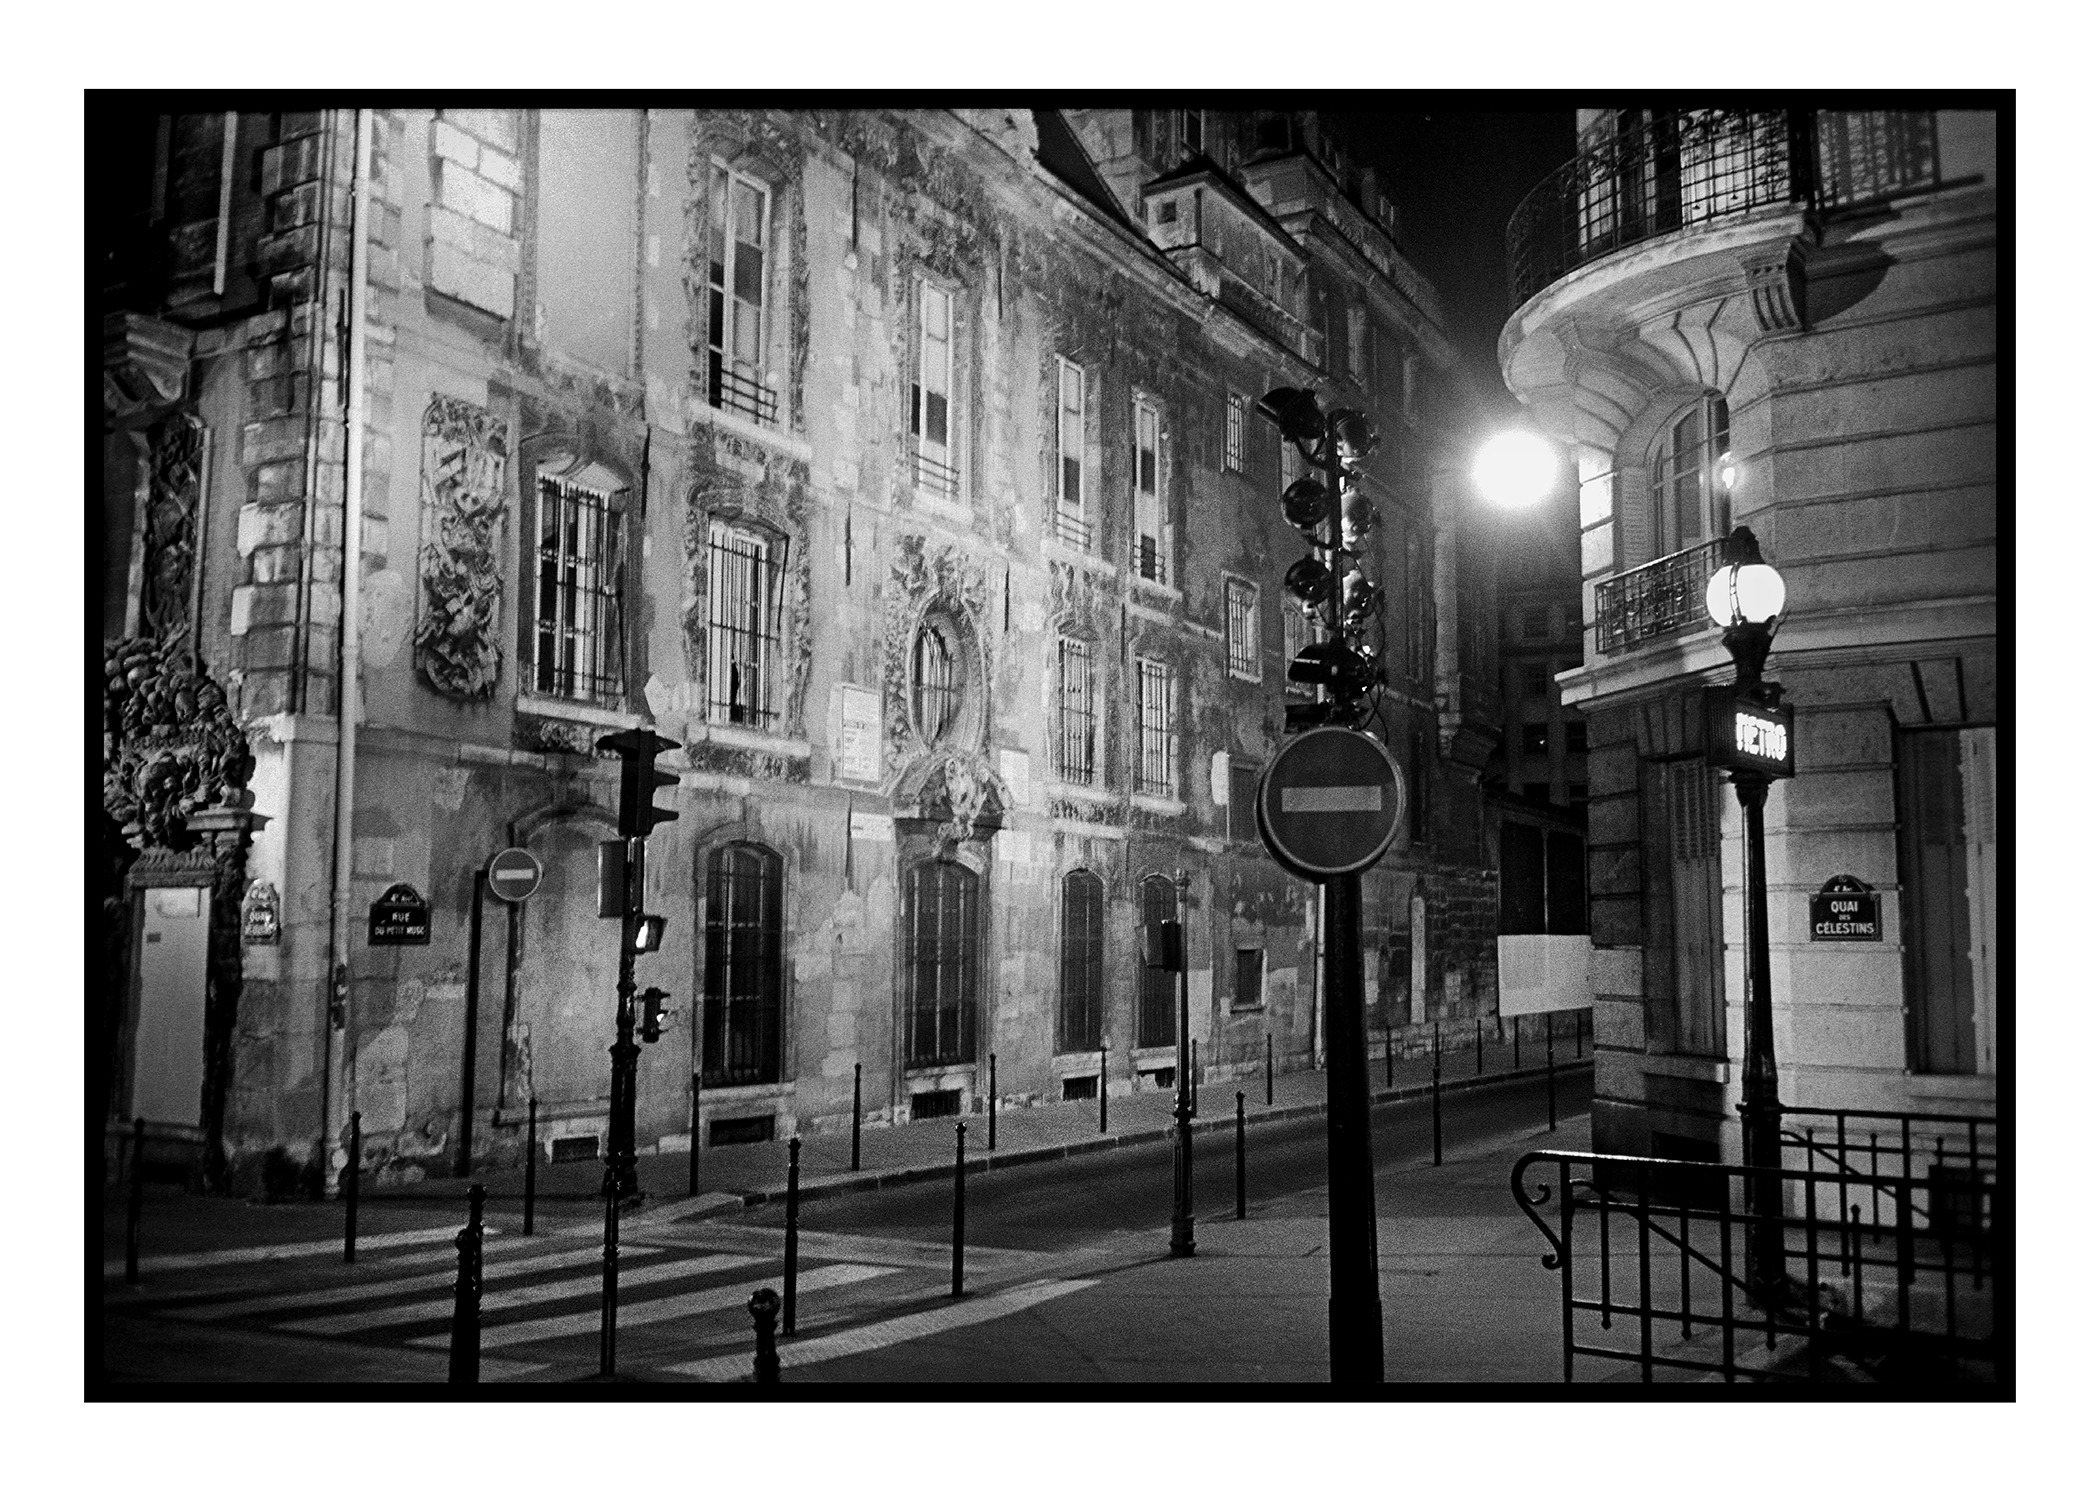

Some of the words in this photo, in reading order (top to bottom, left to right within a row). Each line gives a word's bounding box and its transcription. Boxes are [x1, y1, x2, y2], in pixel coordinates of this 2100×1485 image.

[1830, 901, 1859, 913] QUAI
[392, 911, 410, 923] RUE
[374, 925, 385, 936] DU
[1815, 920, 1875, 935] CÉLESTINS
